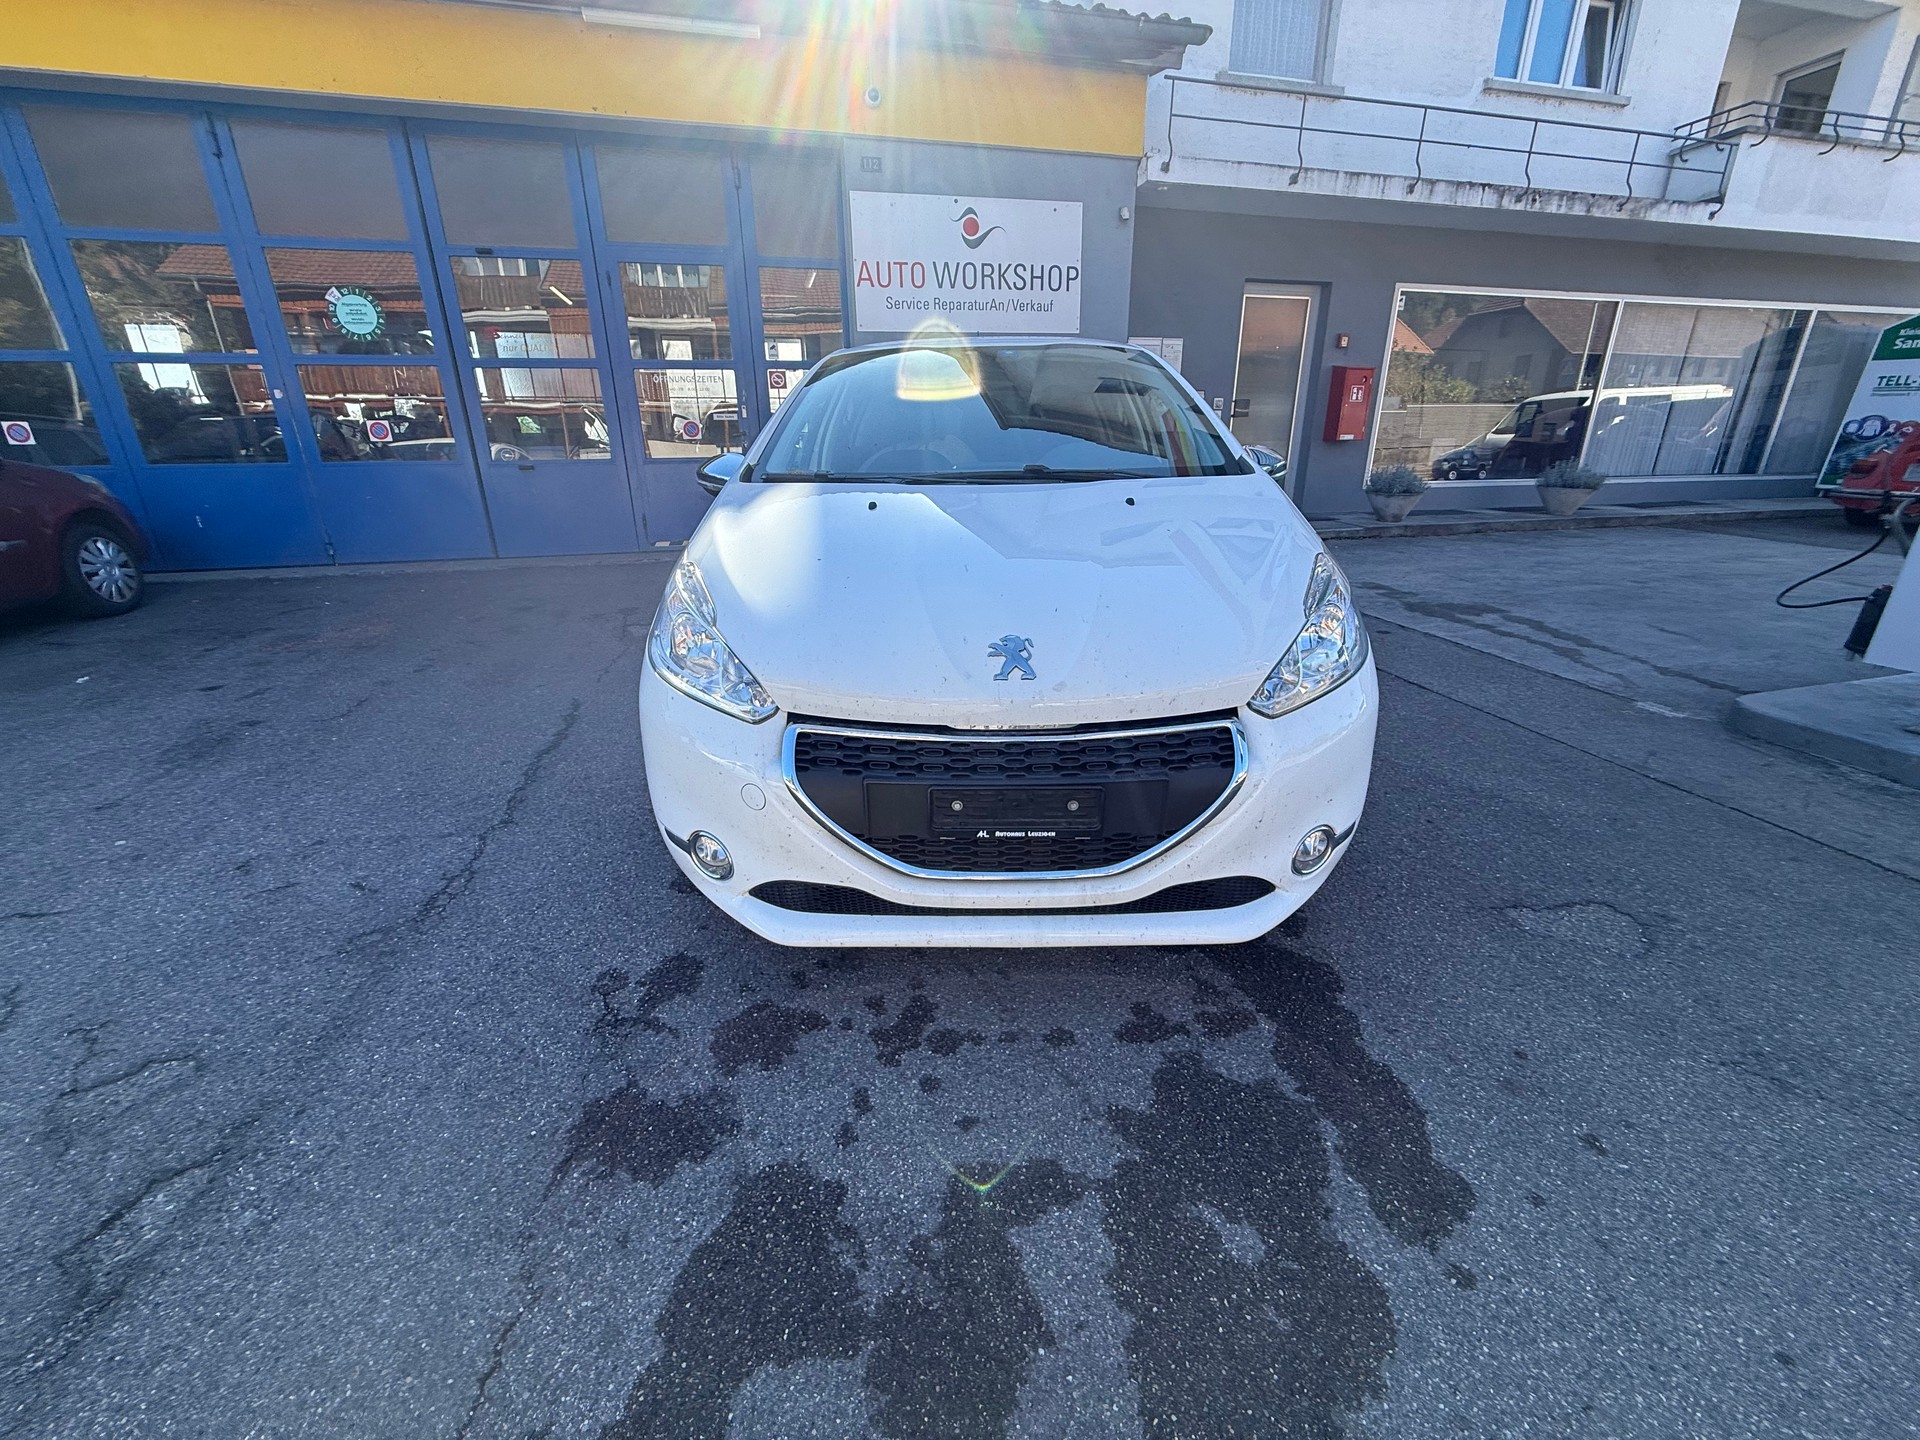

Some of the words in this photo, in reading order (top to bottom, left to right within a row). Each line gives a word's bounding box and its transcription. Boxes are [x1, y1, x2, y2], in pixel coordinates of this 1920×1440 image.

[863, 158, 880, 170] 112
[856, 260, 926, 289] AUTO
[932, 261, 1080, 292] WORKSHOP
[885, 295, 931, 310] Service
[933, 297, 1055, 313] ReparaturAn/Verkauf
[652, 373, 724, 384] ÖFFNUNGSZEITEN
[1877, 374, 1920, 386] TELL-
